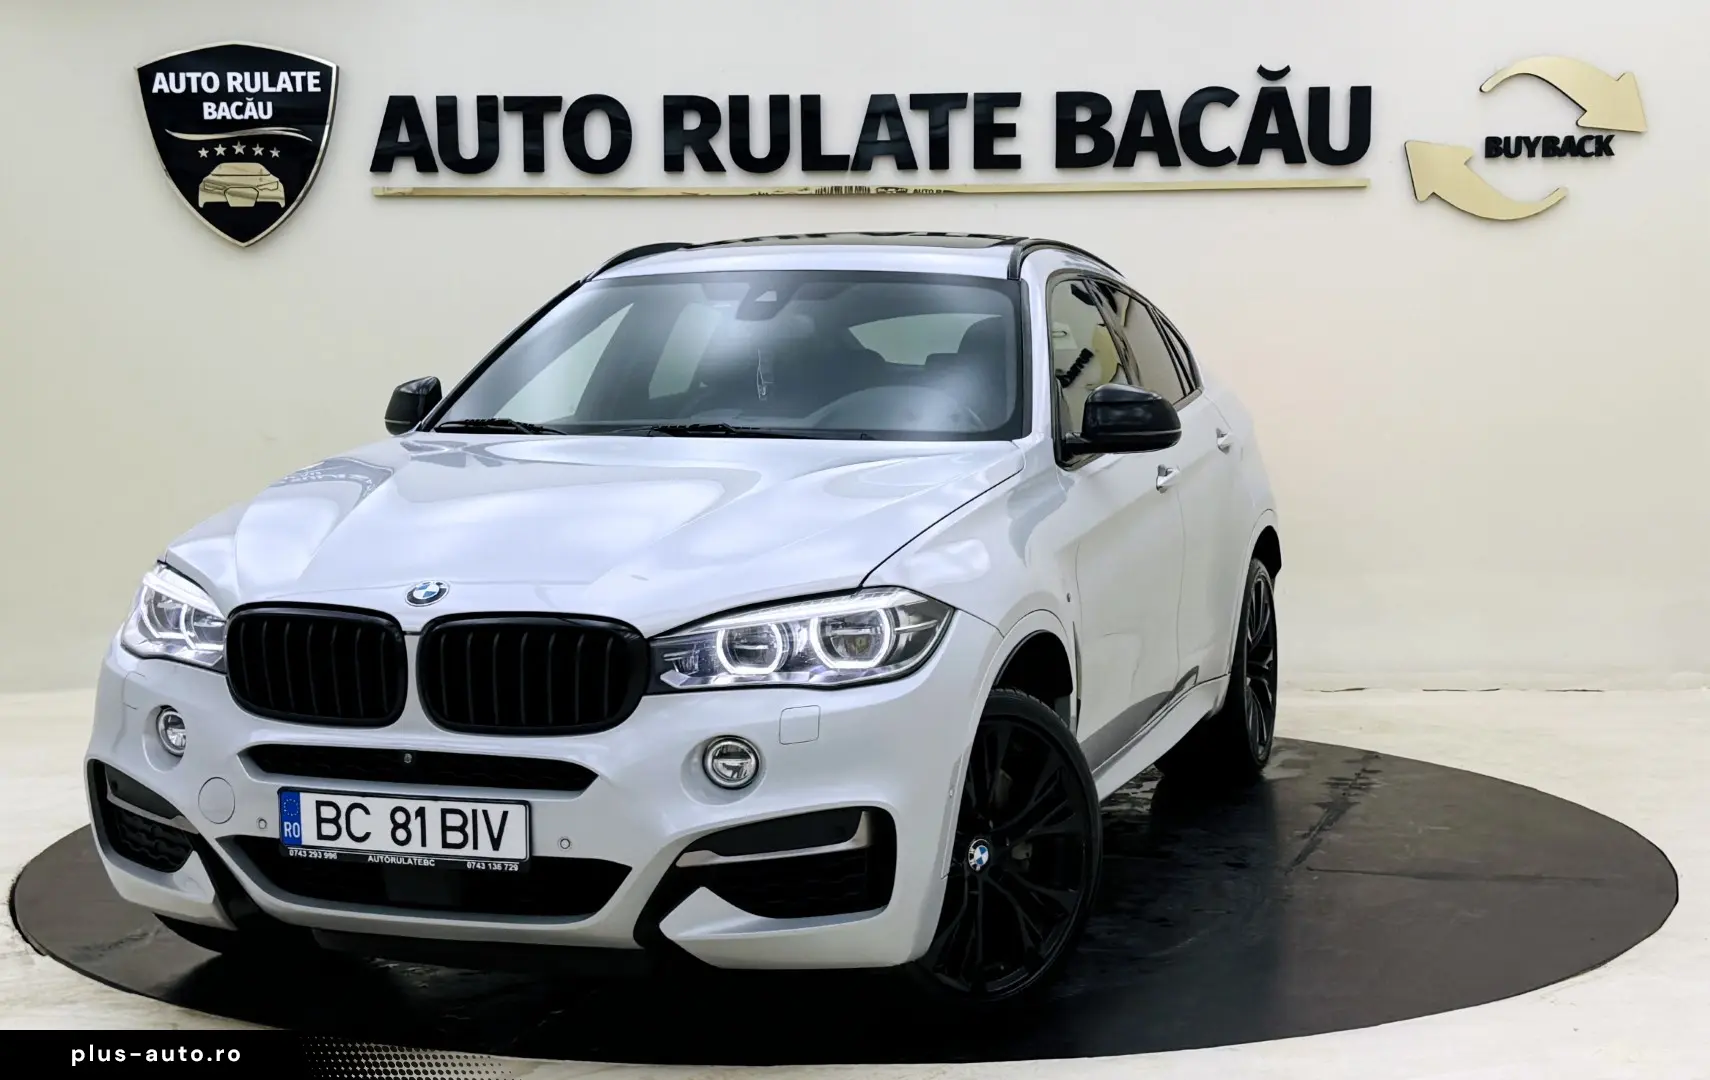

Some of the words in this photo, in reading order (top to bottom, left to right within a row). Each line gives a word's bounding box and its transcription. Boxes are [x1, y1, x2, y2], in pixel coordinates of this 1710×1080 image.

[152, 71, 220, 93] AUTO
[226, 71, 321, 92] RULATE
[203, 97, 273, 120] BACĂU
[369, 93, 633, 175] AUTO
[663, 92, 1021, 173] RULATE
[1055, 65, 1372, 169] BACĂU
[1484, 134, 1615, 158] BUYBACK
[284, 821, 300, 839] RO
[315, 800, 371, 843] BC
[389, 805, 427, 848] 81
[440, 808, 509, 851] BIV
[289, 849, 307, 857] 0743
[466, 861, 486, 870] 0743
